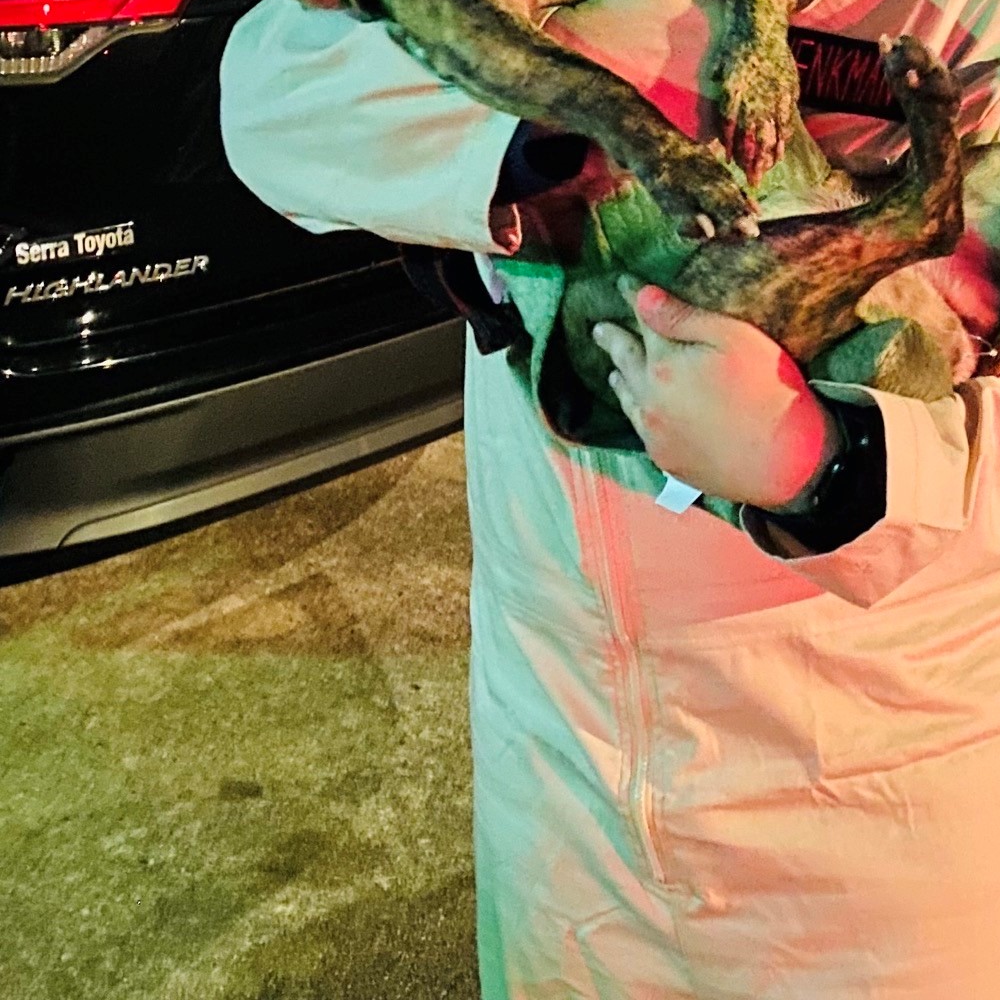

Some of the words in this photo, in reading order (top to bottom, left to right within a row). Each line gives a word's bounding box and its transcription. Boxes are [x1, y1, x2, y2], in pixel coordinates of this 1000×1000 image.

[790, 36, 893, 107] ENKMA
[15, 240, 70, 266] Serra
[73, 226, 135, 257] Toyota
[4, 254, 210, 306] HIGHLANDER
